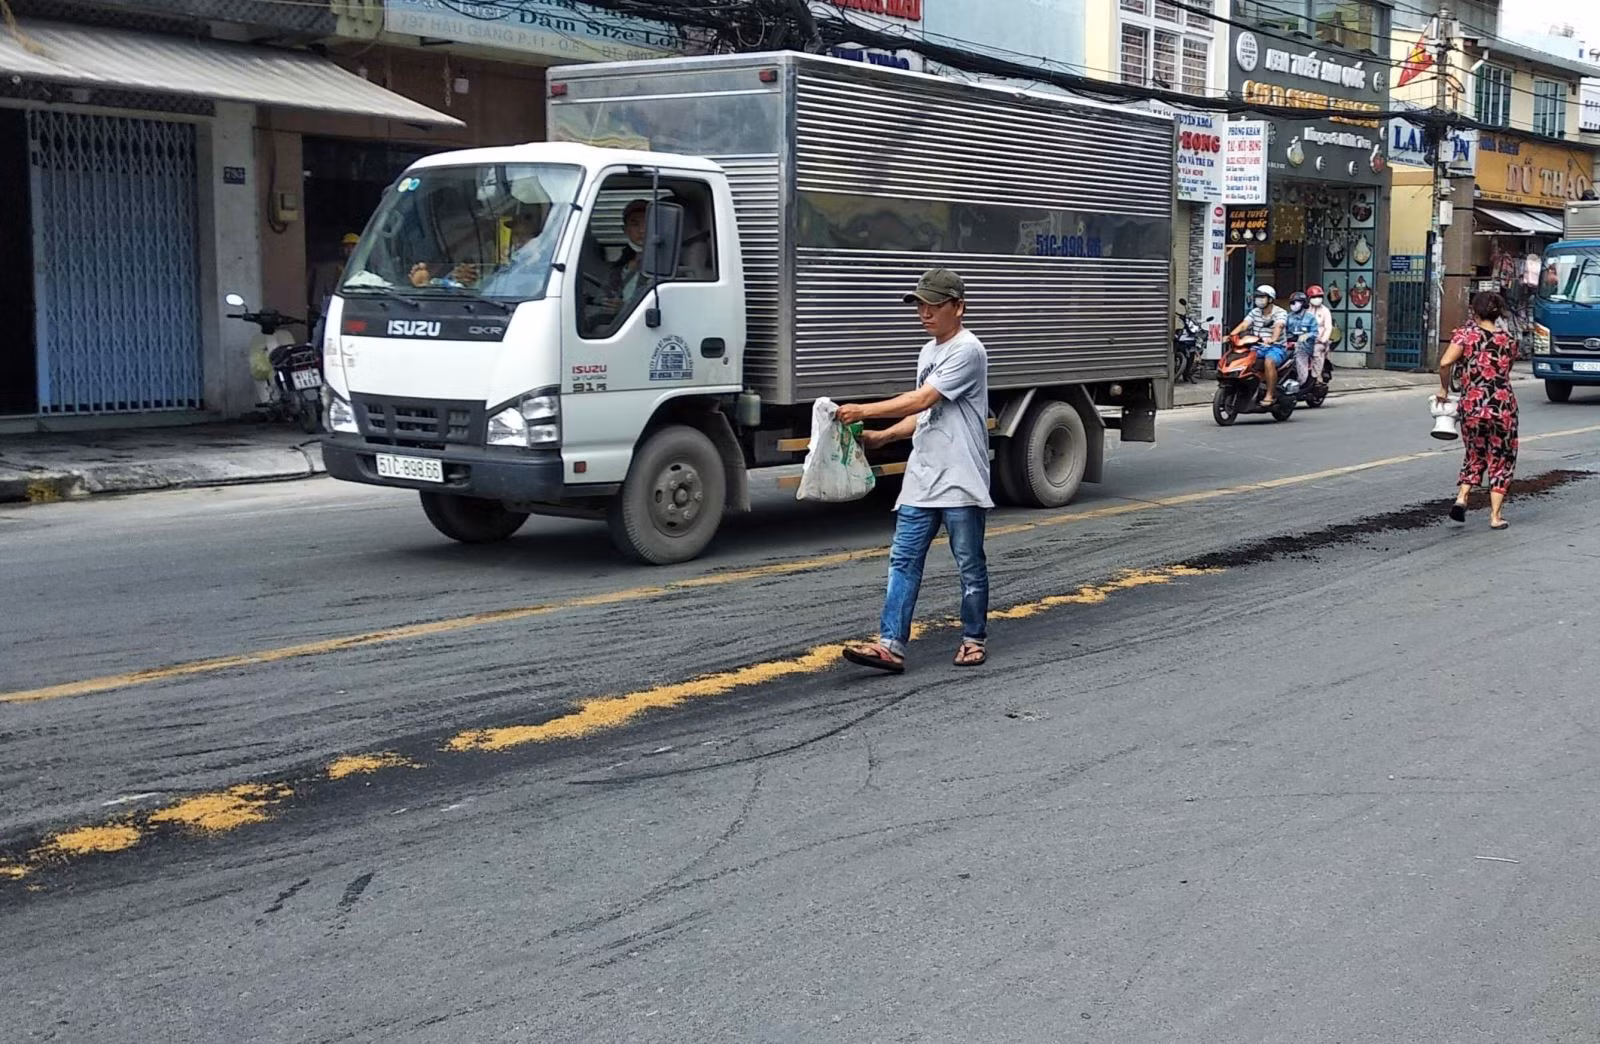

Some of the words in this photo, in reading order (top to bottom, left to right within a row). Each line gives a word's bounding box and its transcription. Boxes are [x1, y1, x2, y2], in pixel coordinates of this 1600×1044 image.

[468, 24, 513, 42] GIANG
[587, 21, 634, 41] Size
[387, 320, 441, 337] ISUZU
[572, 365, 607, 374] ISUZU
